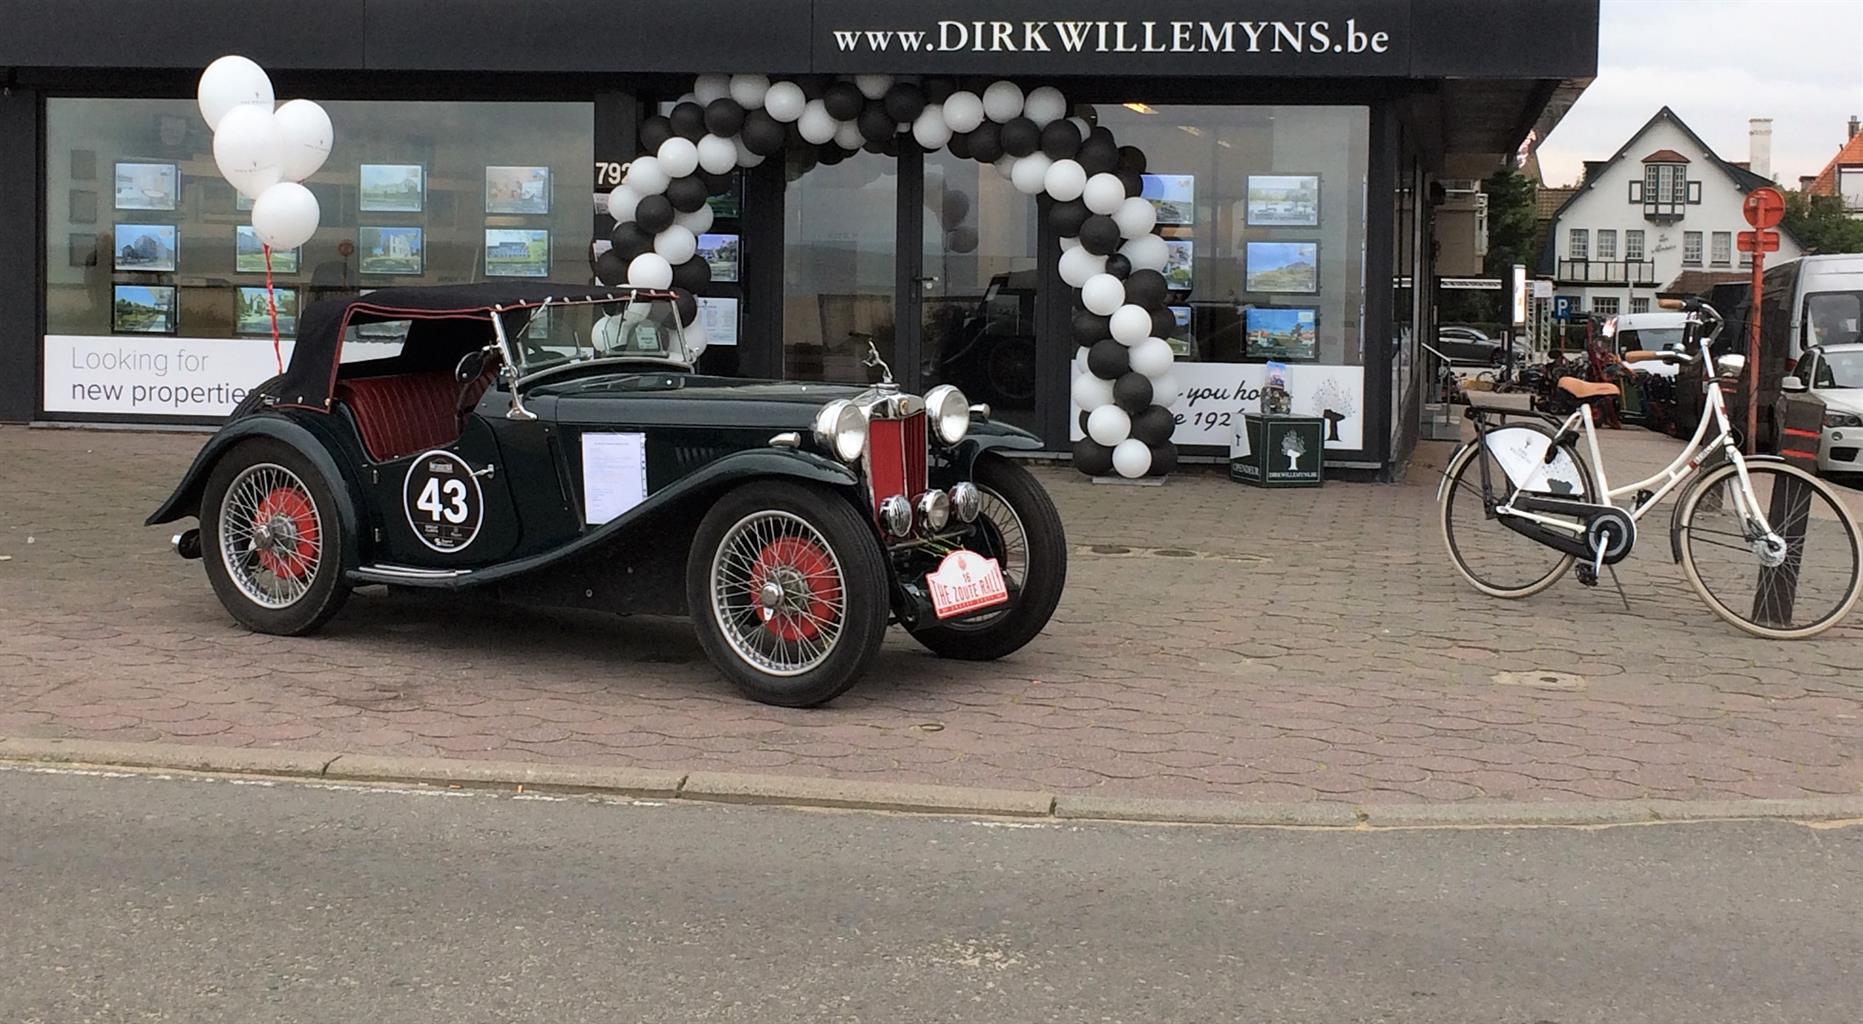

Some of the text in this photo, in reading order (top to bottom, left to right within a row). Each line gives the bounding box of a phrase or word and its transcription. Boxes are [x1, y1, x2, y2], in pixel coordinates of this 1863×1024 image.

[833, 18, 1390, 54] www.DIRKWILLEMYNS.be
[1558, 299, 1568, 316] P
[71, 347, 208, 377] Looking for
[72, 384, 123, 400] new
[1187, 380, 1262, 407] you ho
[1194, 408, 1245, 432] 192
[417, 477, 468, 524] 43
[931, 580, 953, 607] THE
[953, 583, 979, 602] ZOUTE
[979, 563, 1003, 594] RALLY
